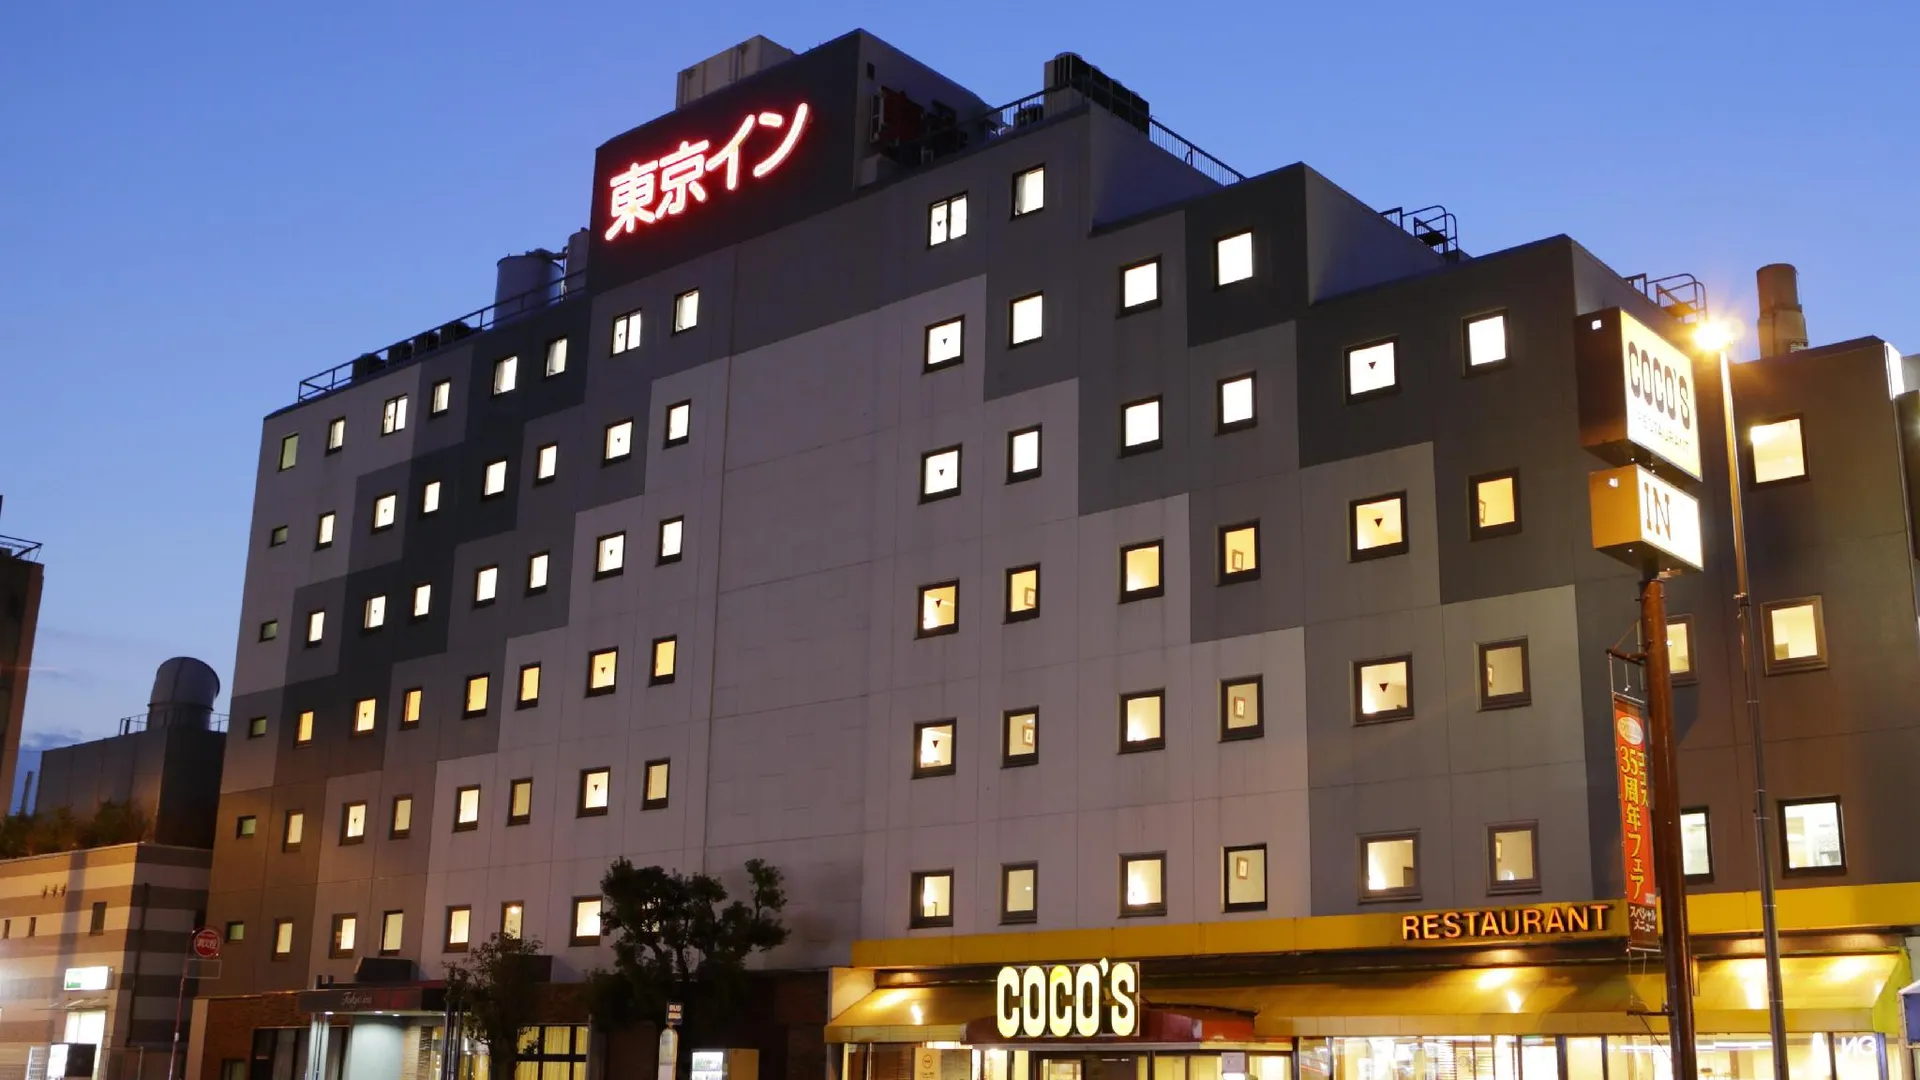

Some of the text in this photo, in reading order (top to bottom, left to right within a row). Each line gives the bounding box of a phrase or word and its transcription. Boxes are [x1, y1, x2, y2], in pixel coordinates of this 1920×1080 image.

[605, 102, 808, 241] 東京イン
[1628, 341, 1690, 430] COCO'S
[1643, 482, 1671, 541] IN
[1620, 746, 1644, 899] 35周年フェア
[1402, 904, 1609, 940] RESTAURANT
[996, 958, 1136, 1038] COCO'S
